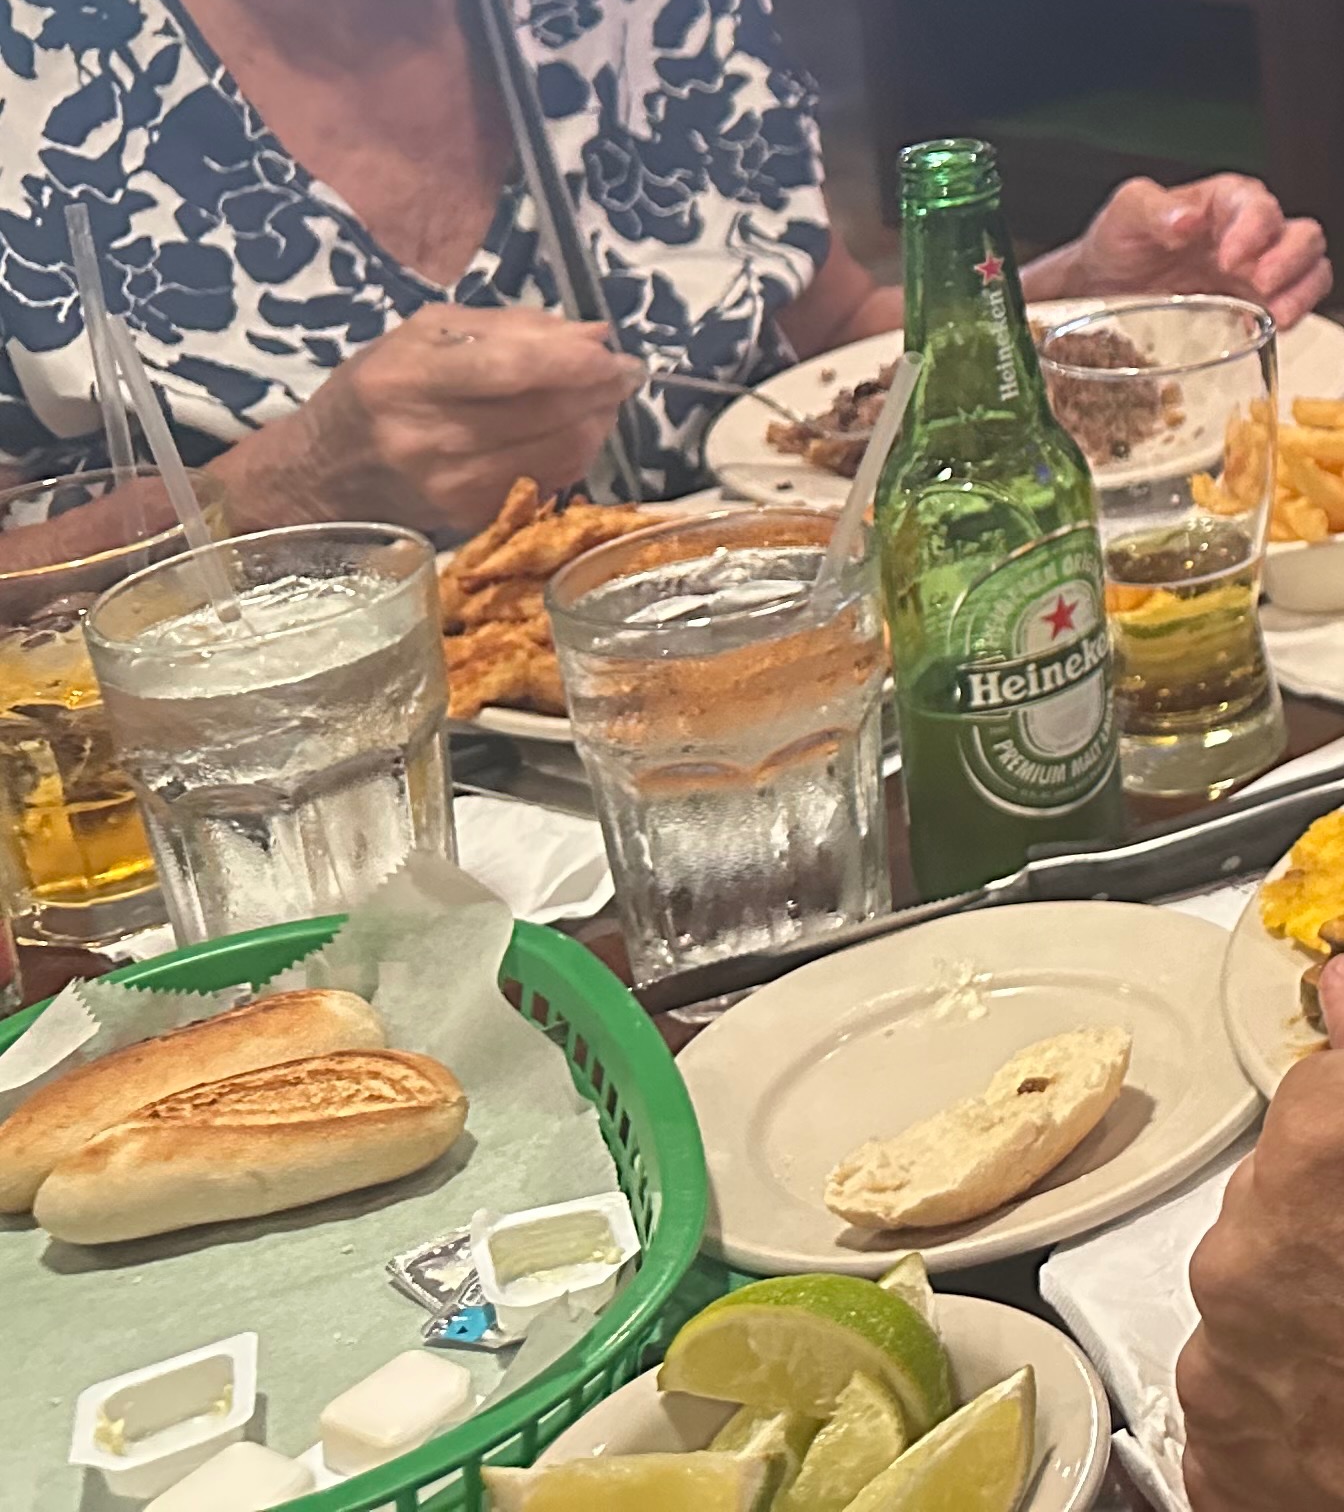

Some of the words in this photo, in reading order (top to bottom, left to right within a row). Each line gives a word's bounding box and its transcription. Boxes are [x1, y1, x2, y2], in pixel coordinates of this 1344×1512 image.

[989, 289, 1020, 402] Heineken
[968, 632, 1110, 708] Heineke
[992, 738, 1067, 785] PREMIUM
